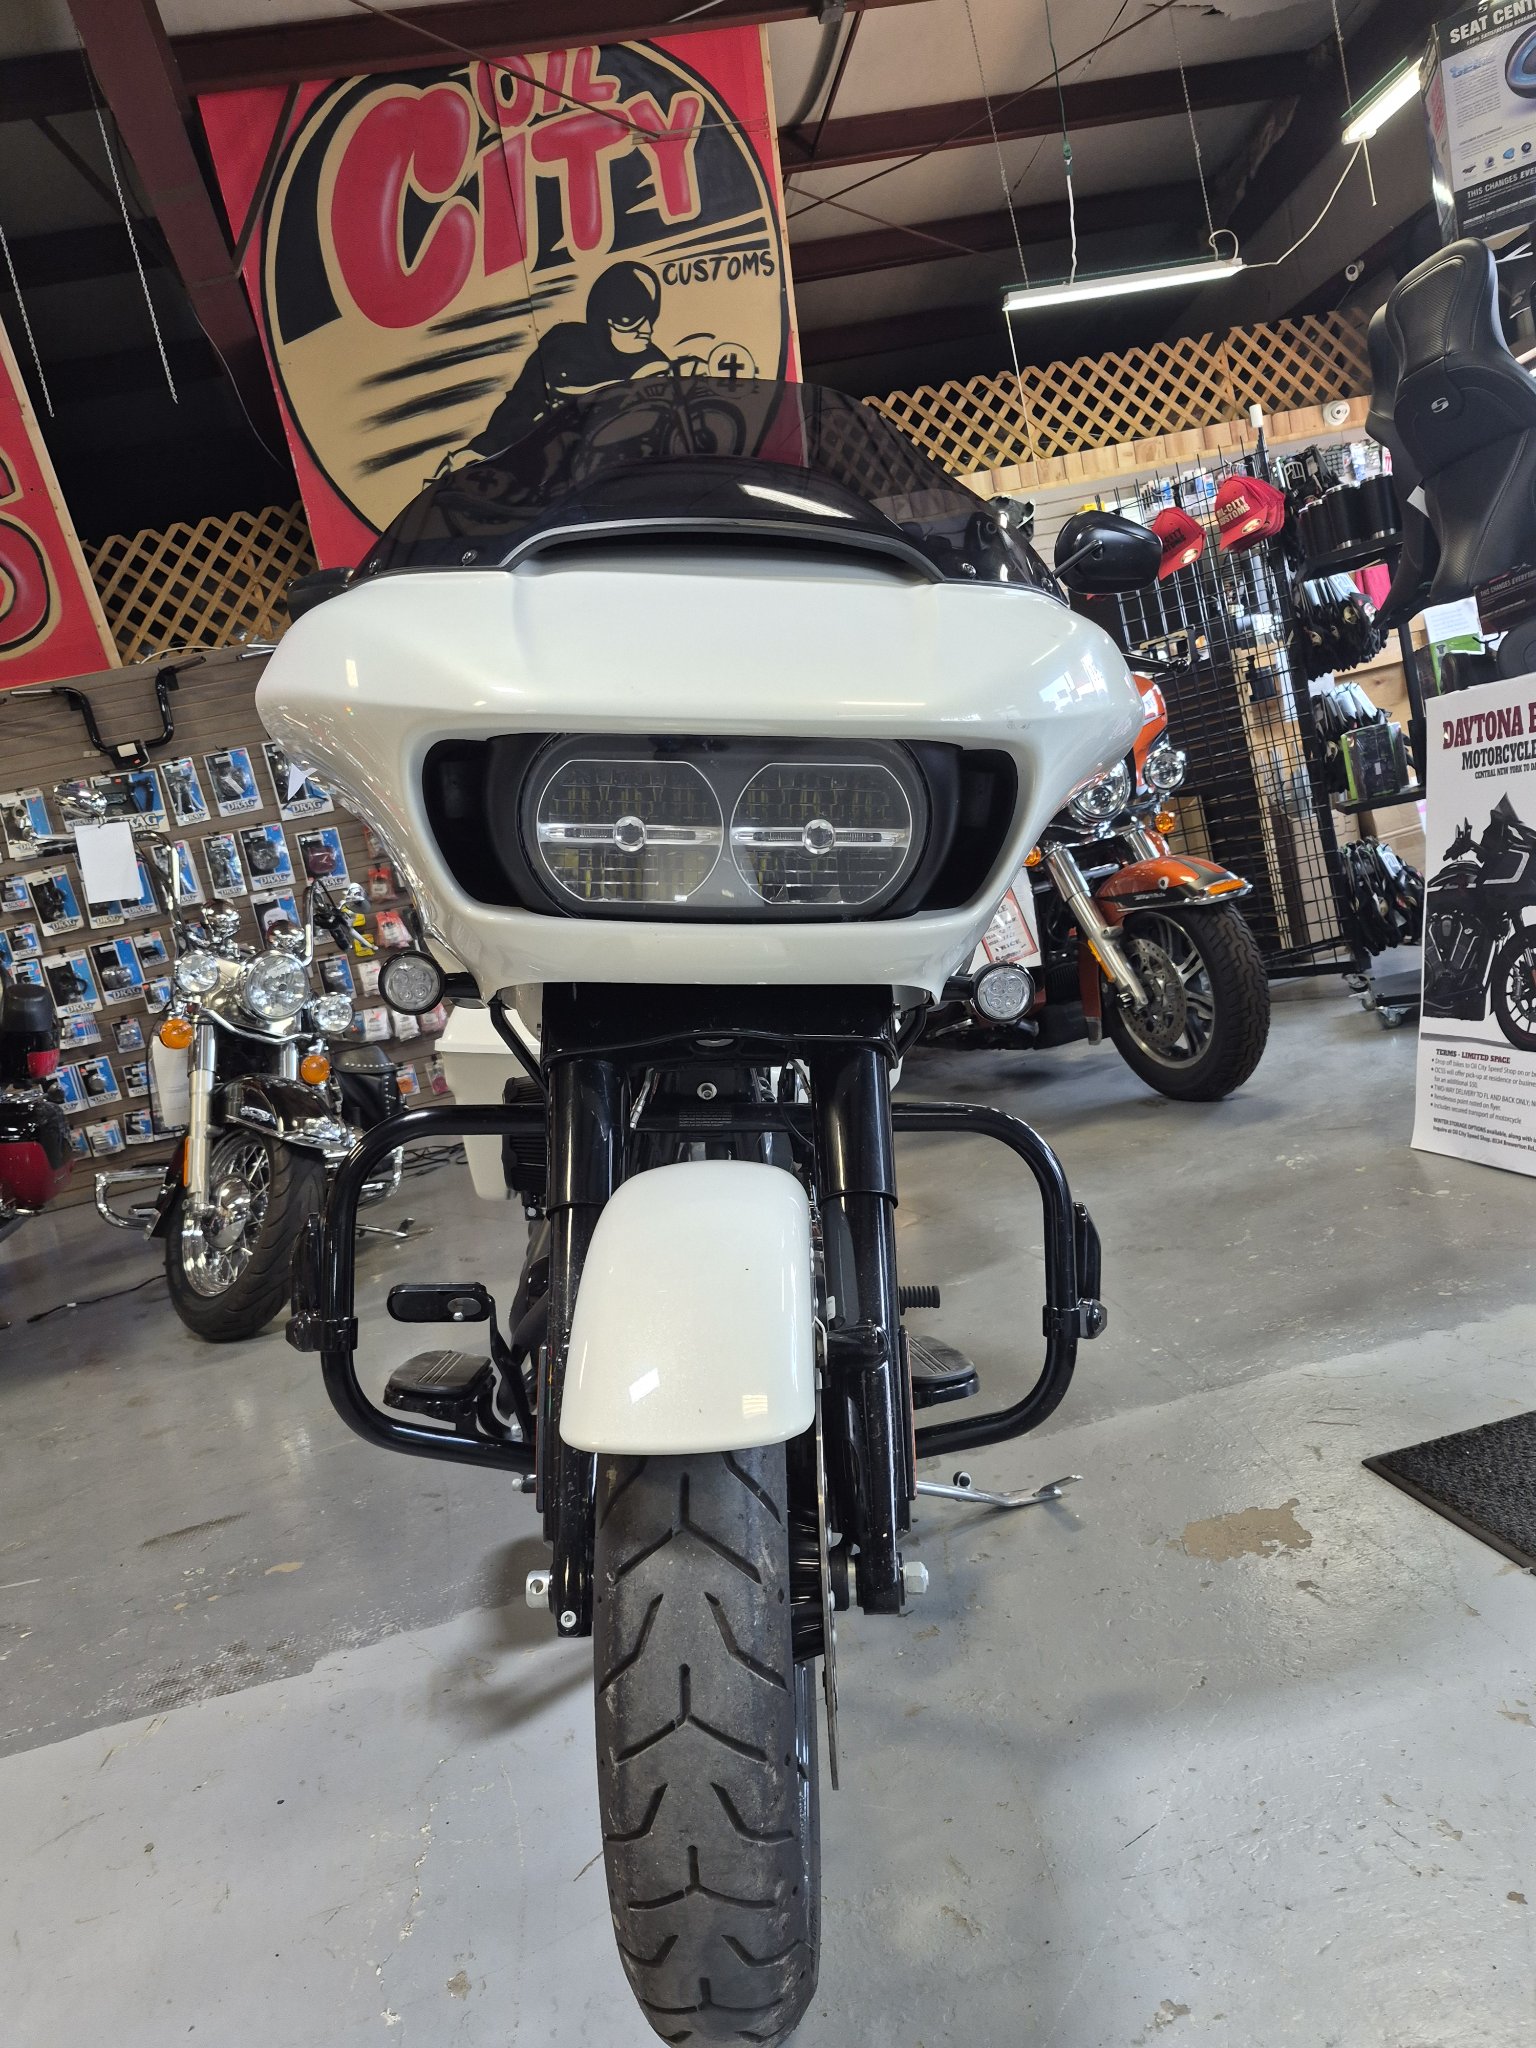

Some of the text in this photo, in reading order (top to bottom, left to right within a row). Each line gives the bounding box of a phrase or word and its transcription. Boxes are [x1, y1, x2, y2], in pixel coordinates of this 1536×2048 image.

[1450, 0, 1536, 44] SEAT CENT
[474, 46, 617, 126] OIL
[1467, 187, 1483, 198] THIS
[1485, 174, 1518, 192] CHANGES
[329, 87, 701, 329] CITY
[661, 249, 776, 287] CUSTOMS
[1443, 705, 1524, 749] DAYTONA
[1475, 768, 1496, 779] CENTRAL
[1497, 766, 1508, 776] NEW
[1510, 764, 1522, 774] YORK
[1523, 763, 1530, 772] TO
[226, 800, 254, 812] DRAG
[291, 801, 322, 814] DRAG
[260, 874, 287, 886] DRAG
[50, 920, 77, 932] DRAG
[112, 986, 140, 999] DRAG
[66, 1002, 93, 1014] DRAG
[1436, 1049, 1457, 1057] TERMS
[1461, 1052, 1489, 1061] LIMITED
[1490, 1055, 1510, 1064] SPACE
[1466, 1071, 1482, 1080] pick-up
[1489, 1074, 1512, 1083] residence
[1504, 1067, 1516, 1075] Shop
[1456, 1088, 1476, 1097] DELIVERY
[1495, 1114, 1521, 1124] motorcycle
[1468, 1124, 1486, 1132] OPTIONS
